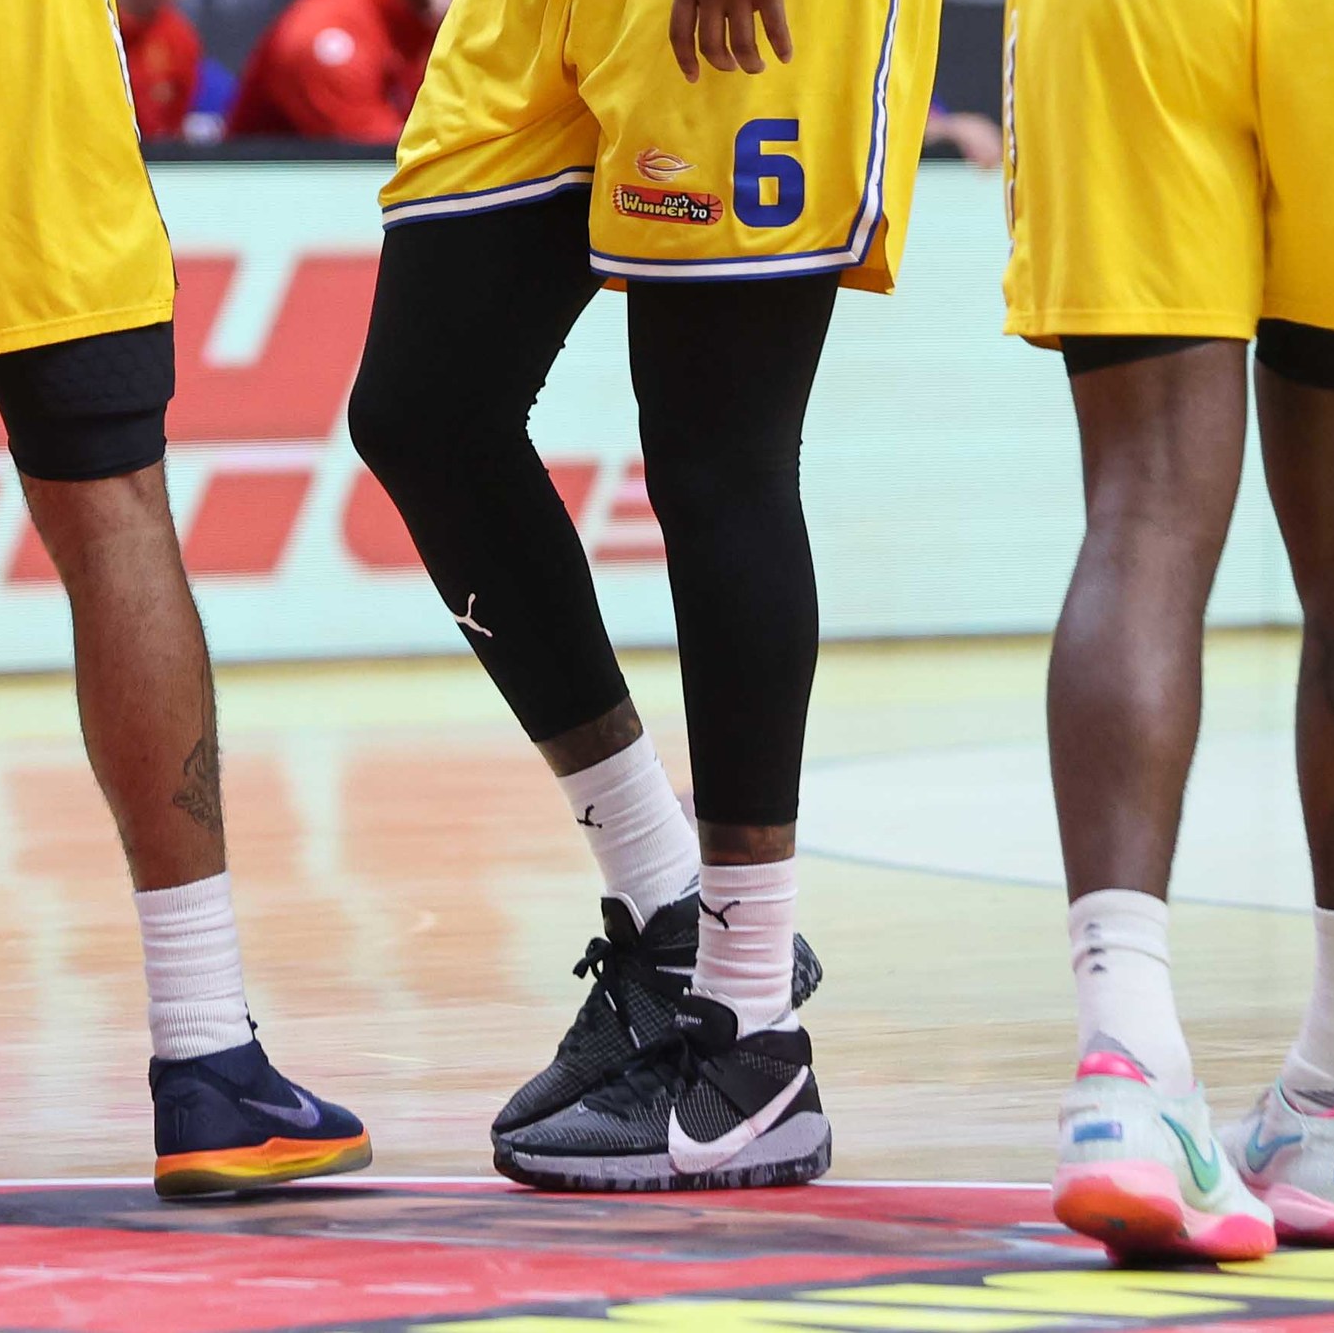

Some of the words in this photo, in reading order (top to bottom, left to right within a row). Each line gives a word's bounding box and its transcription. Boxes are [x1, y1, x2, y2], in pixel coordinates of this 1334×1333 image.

[733, 118, 805, 228] 6
[622, 193, 689, 218] Winner
[690, 205, 708, 219] סל
[663, 195, 689, 207] ליגת
